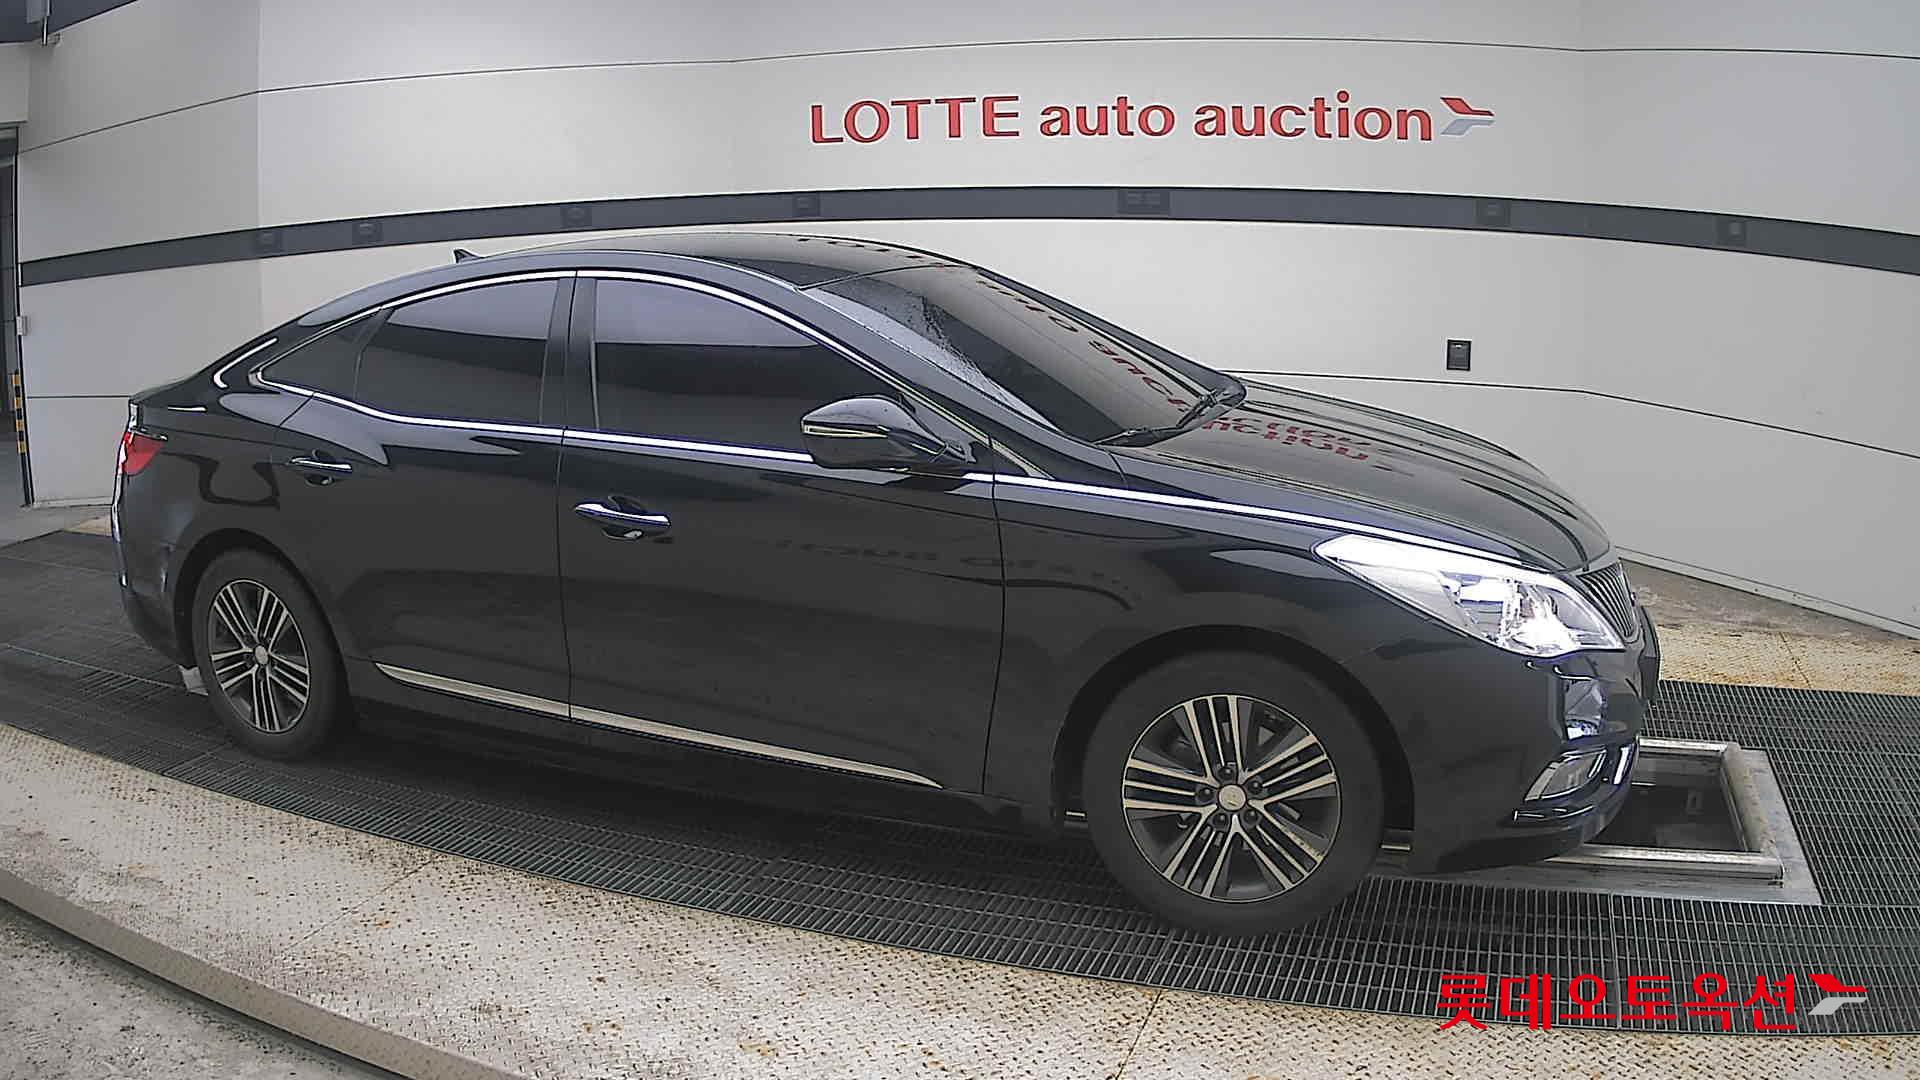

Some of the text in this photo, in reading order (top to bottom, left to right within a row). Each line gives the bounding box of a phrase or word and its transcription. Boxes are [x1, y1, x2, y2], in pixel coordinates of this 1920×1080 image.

[811, 90, 1432, 144] LOTTE auto auction
